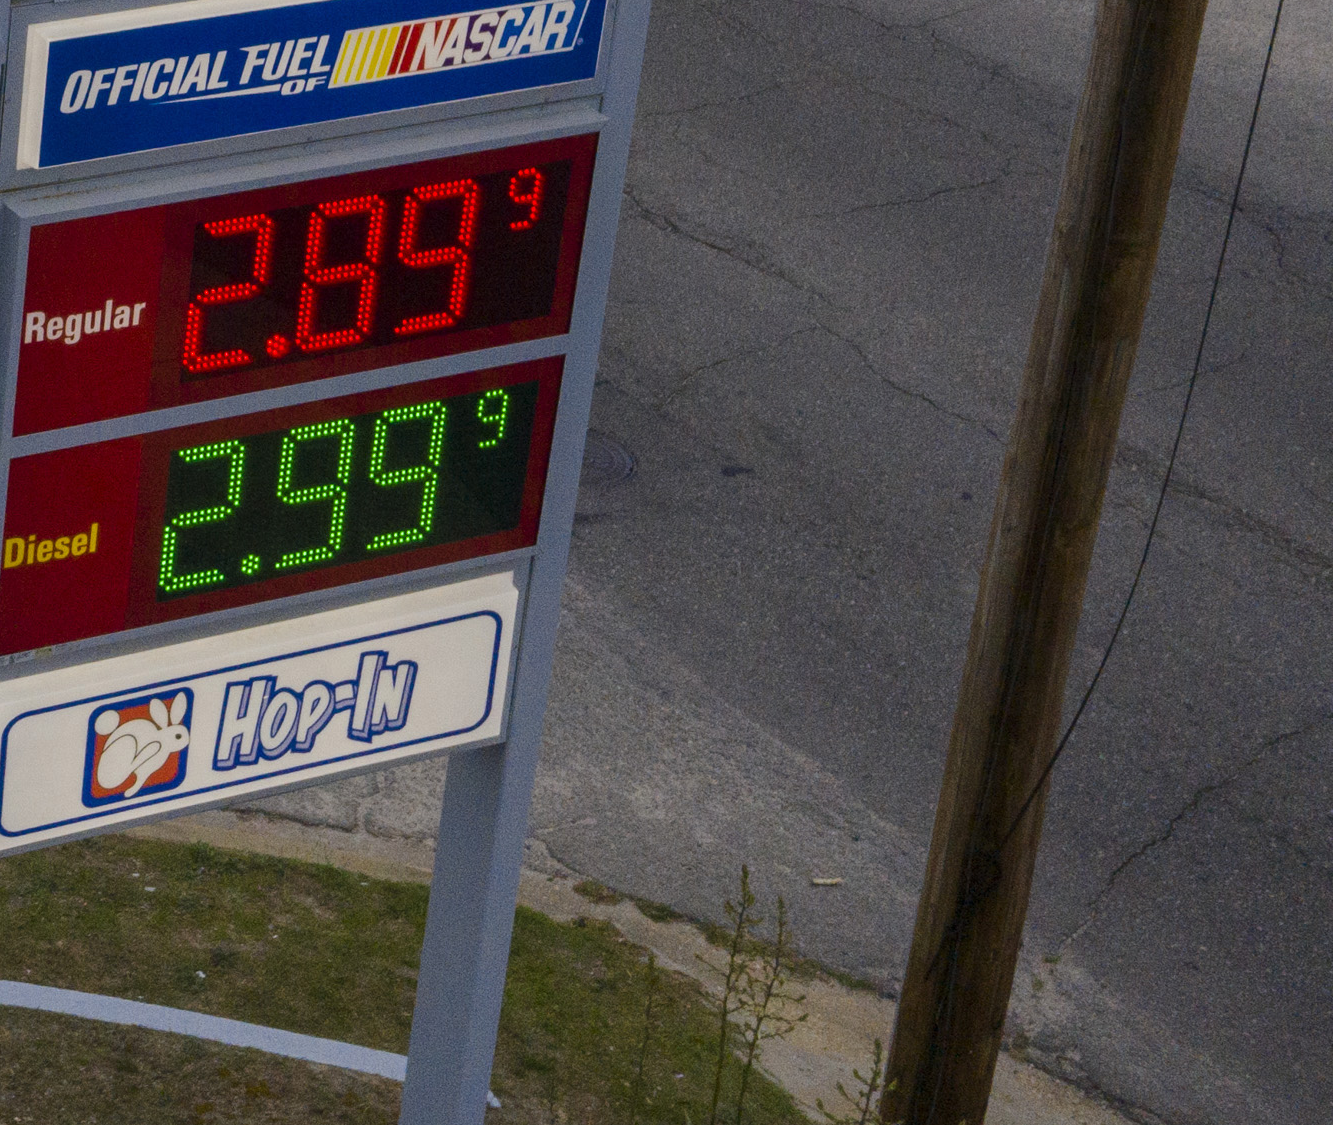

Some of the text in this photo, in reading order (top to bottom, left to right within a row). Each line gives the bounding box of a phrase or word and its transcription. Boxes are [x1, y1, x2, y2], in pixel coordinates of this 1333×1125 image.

[59, 35, 331, 114] OFFICIAL FUEL
[412, 3, 574, 71] NASCAR
[280, 76, 327, 96] OF
[24, 166, 541, 372] Regular 2.89 9
[3, 388, 509, 592] Diesel 2.99 9
